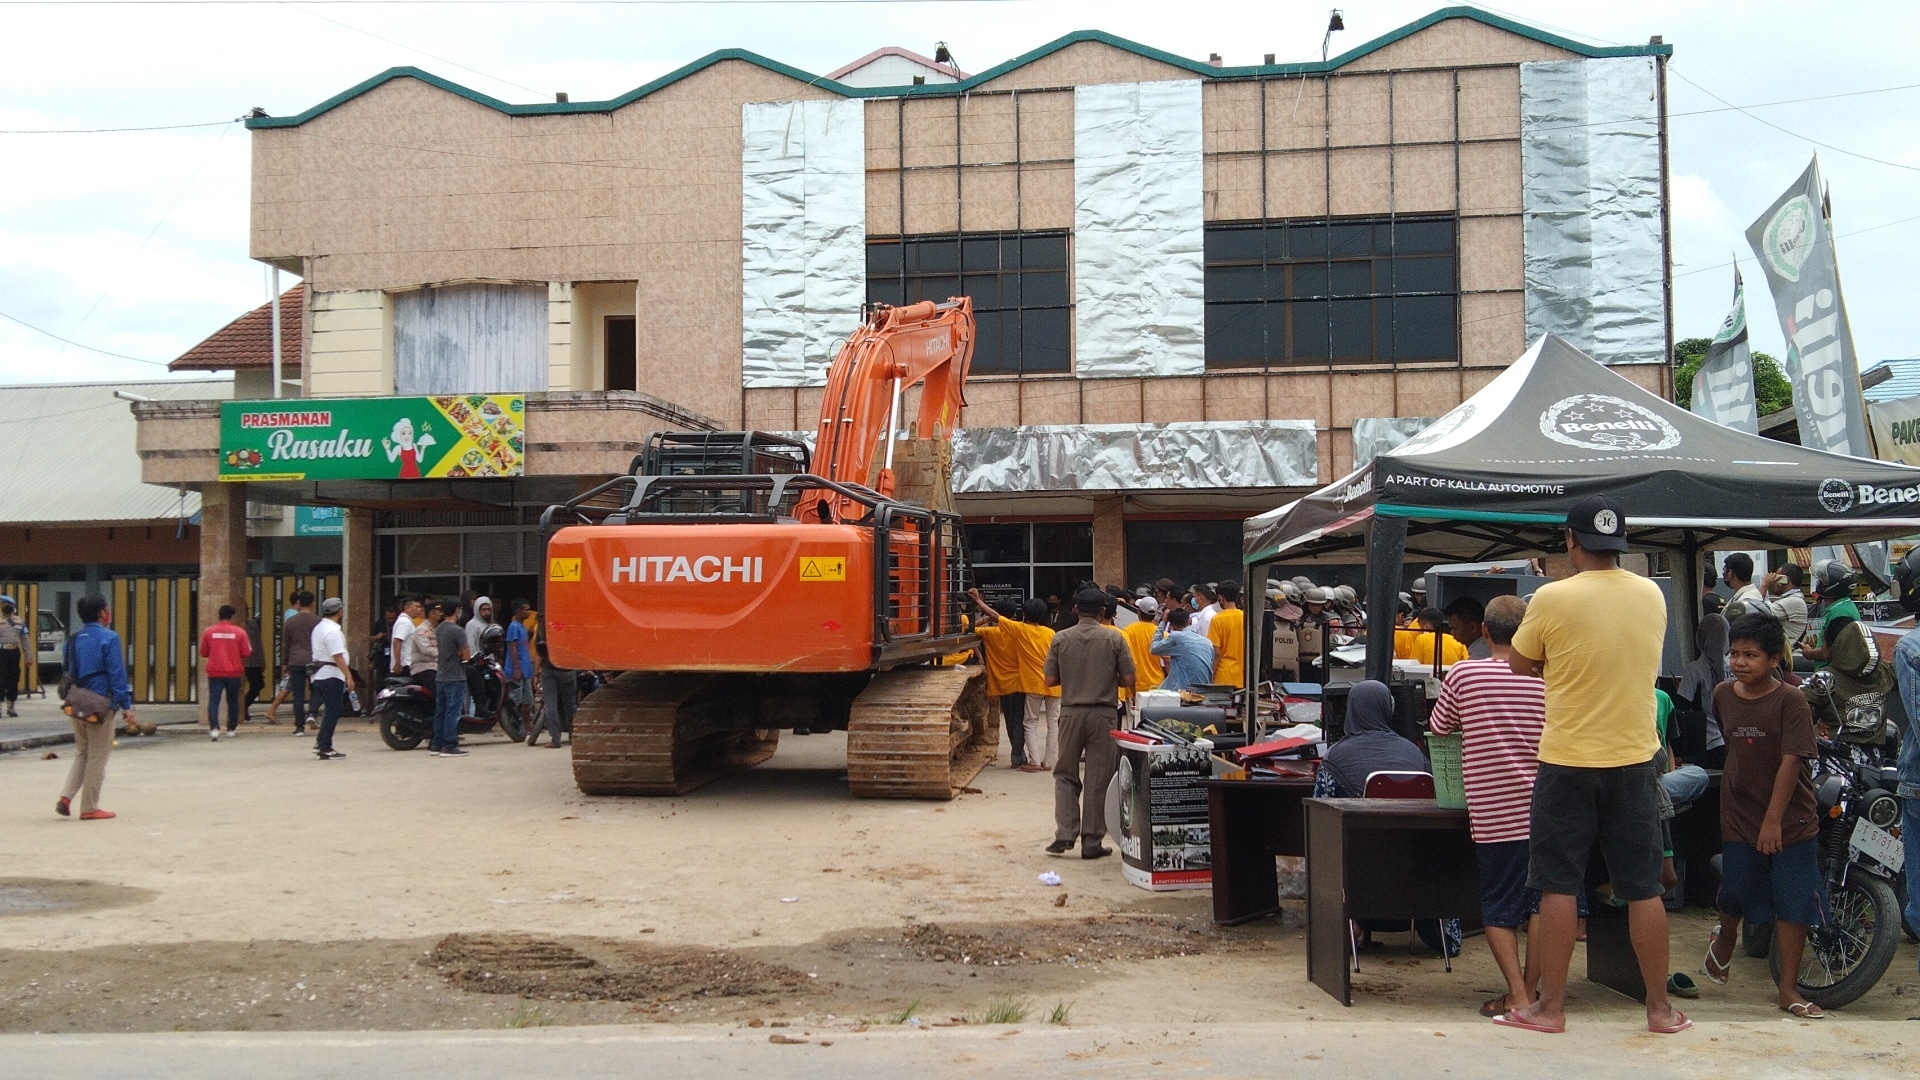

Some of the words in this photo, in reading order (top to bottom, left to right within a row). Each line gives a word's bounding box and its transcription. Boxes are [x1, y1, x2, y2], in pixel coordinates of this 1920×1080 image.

[925, 333, 950, 357] HITACHI
[242, 412, 331, 428] PRASMANAN
[1560, 420, 1658, 434] Benelli
[267, 429, 373, 460] Rasaku
[1386, 474, 1395, 484] A
[1397, 475, 1428, 487] PART
[1430, 478, 1446, 488] OF
[1448, 480, 1486, 491] KALLA
[1488, 484, 1564, 495] AUTOMOTIVE
[1823, 490, 1849, 498] Benelli
[612, 555, 763, 583] HITACHI
[1274, 637, 1293, 645] POLISI
[1871, 830, 1892, 850] 6281
